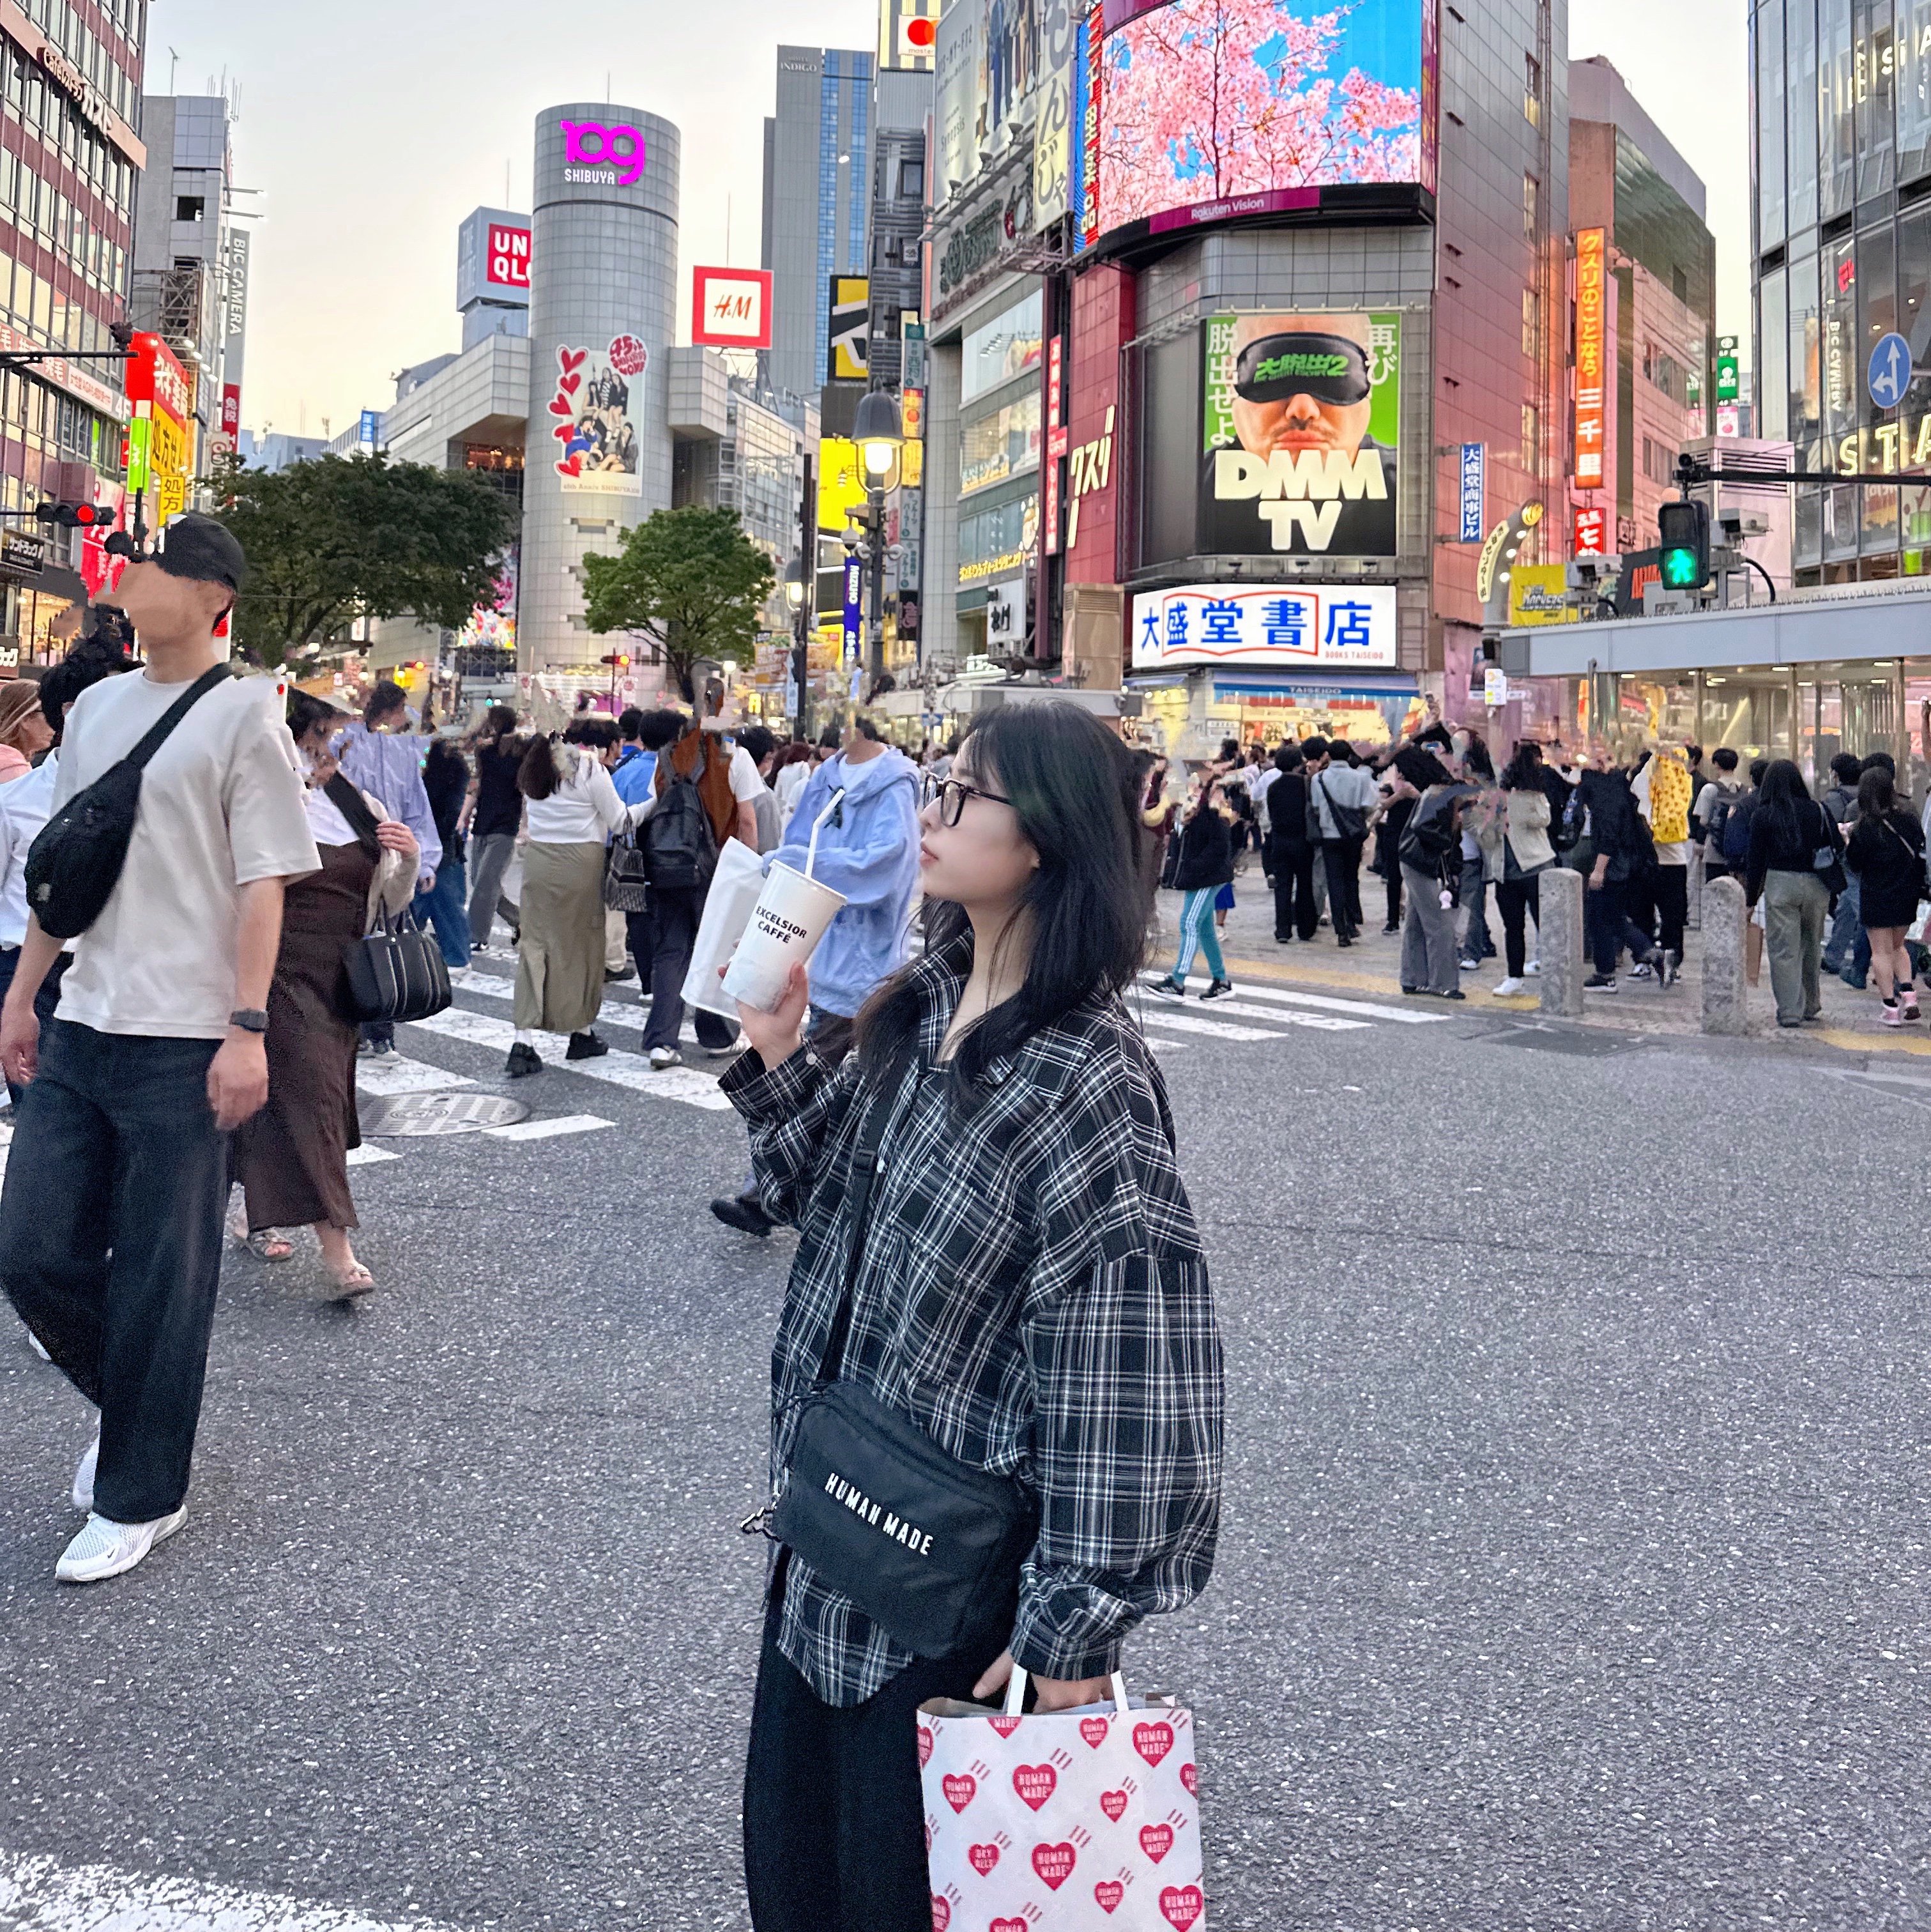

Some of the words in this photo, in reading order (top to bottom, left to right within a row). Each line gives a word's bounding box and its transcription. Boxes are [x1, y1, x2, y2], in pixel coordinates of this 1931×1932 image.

[781, 62, 817, 72] INDIGO
[560, 119, 646, 185] 109
[564, 168, 615, 185] SHIBUYA
[1191, 203, 1231, 220] Rakuten
[1232, 198, 1265, 212] Vision
[233, 238, 246, 264] BIC
[494, 231, 528, 257] UN
[230, 267, 245, 335] CAMERA
[714, 294, 752, 320] H&M
[1581, 234, 1599, 377] クスリのことなら
[1254, 353, 1349, 382] 大脱出2
[1364, 323, 1398, 386] 再び
[1207, 323, 1238, 446] 脱出せよ
[1578, 387, 1602, 477] 三千里
[1214, 448, 1388, 500] DMM
[1258, 500, 1343, 551] TV
[848, 565, 860, 604] MIZUHO
[1141, 599, 1372, 650] 大盛堂書店
[1325, 651, 1348, 659] BOOKS
[1352, 651, 1384, 659] TAISEIDO
[1289, 686, 1342, 695] TAISEIDO
[756, 905, 807, 939] EXCELSIOR
[758, 920, 792, 944] CAFFÉ
[824, 1472, 882, 1526] HUMAN
[882, 1512, 934, 1556] MADE
[1018, 1772, 1052, 1786] HUMAN
[1022, 1786, 1051, 1798] MADE
[1037, 1851, 1071, 1865] HUMAN
[1040, 1864, 1071, 1878] MADE
[1164, 1894, 1198, 1908] HUMAN
[1168, 1907, 1199, 1920] MADE
